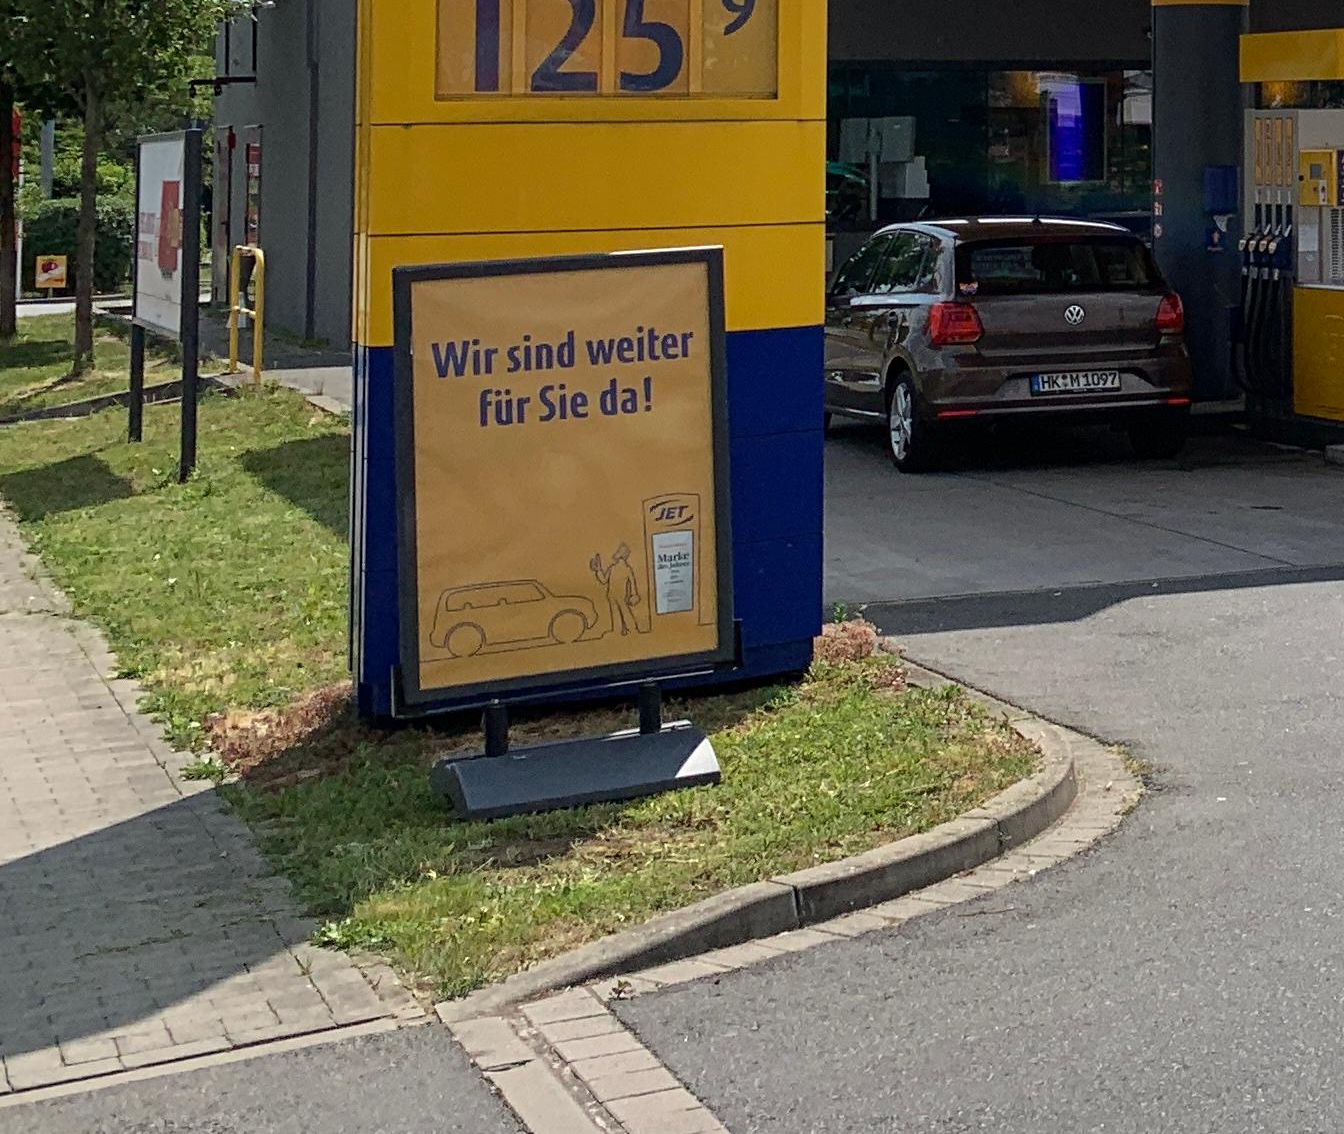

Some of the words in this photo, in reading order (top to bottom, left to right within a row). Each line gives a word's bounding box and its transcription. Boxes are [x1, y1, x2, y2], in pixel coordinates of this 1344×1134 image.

[432, 338, 498, 378] Wir
[507, 331, 575, 373] sind
[587, 326, 694, 365] weiter
[480, 387, 531, 426] für
[539, 383, 588, 422] Sie
[600, 377, 653, 416] da!
[656, 506, 688, 521] JET
